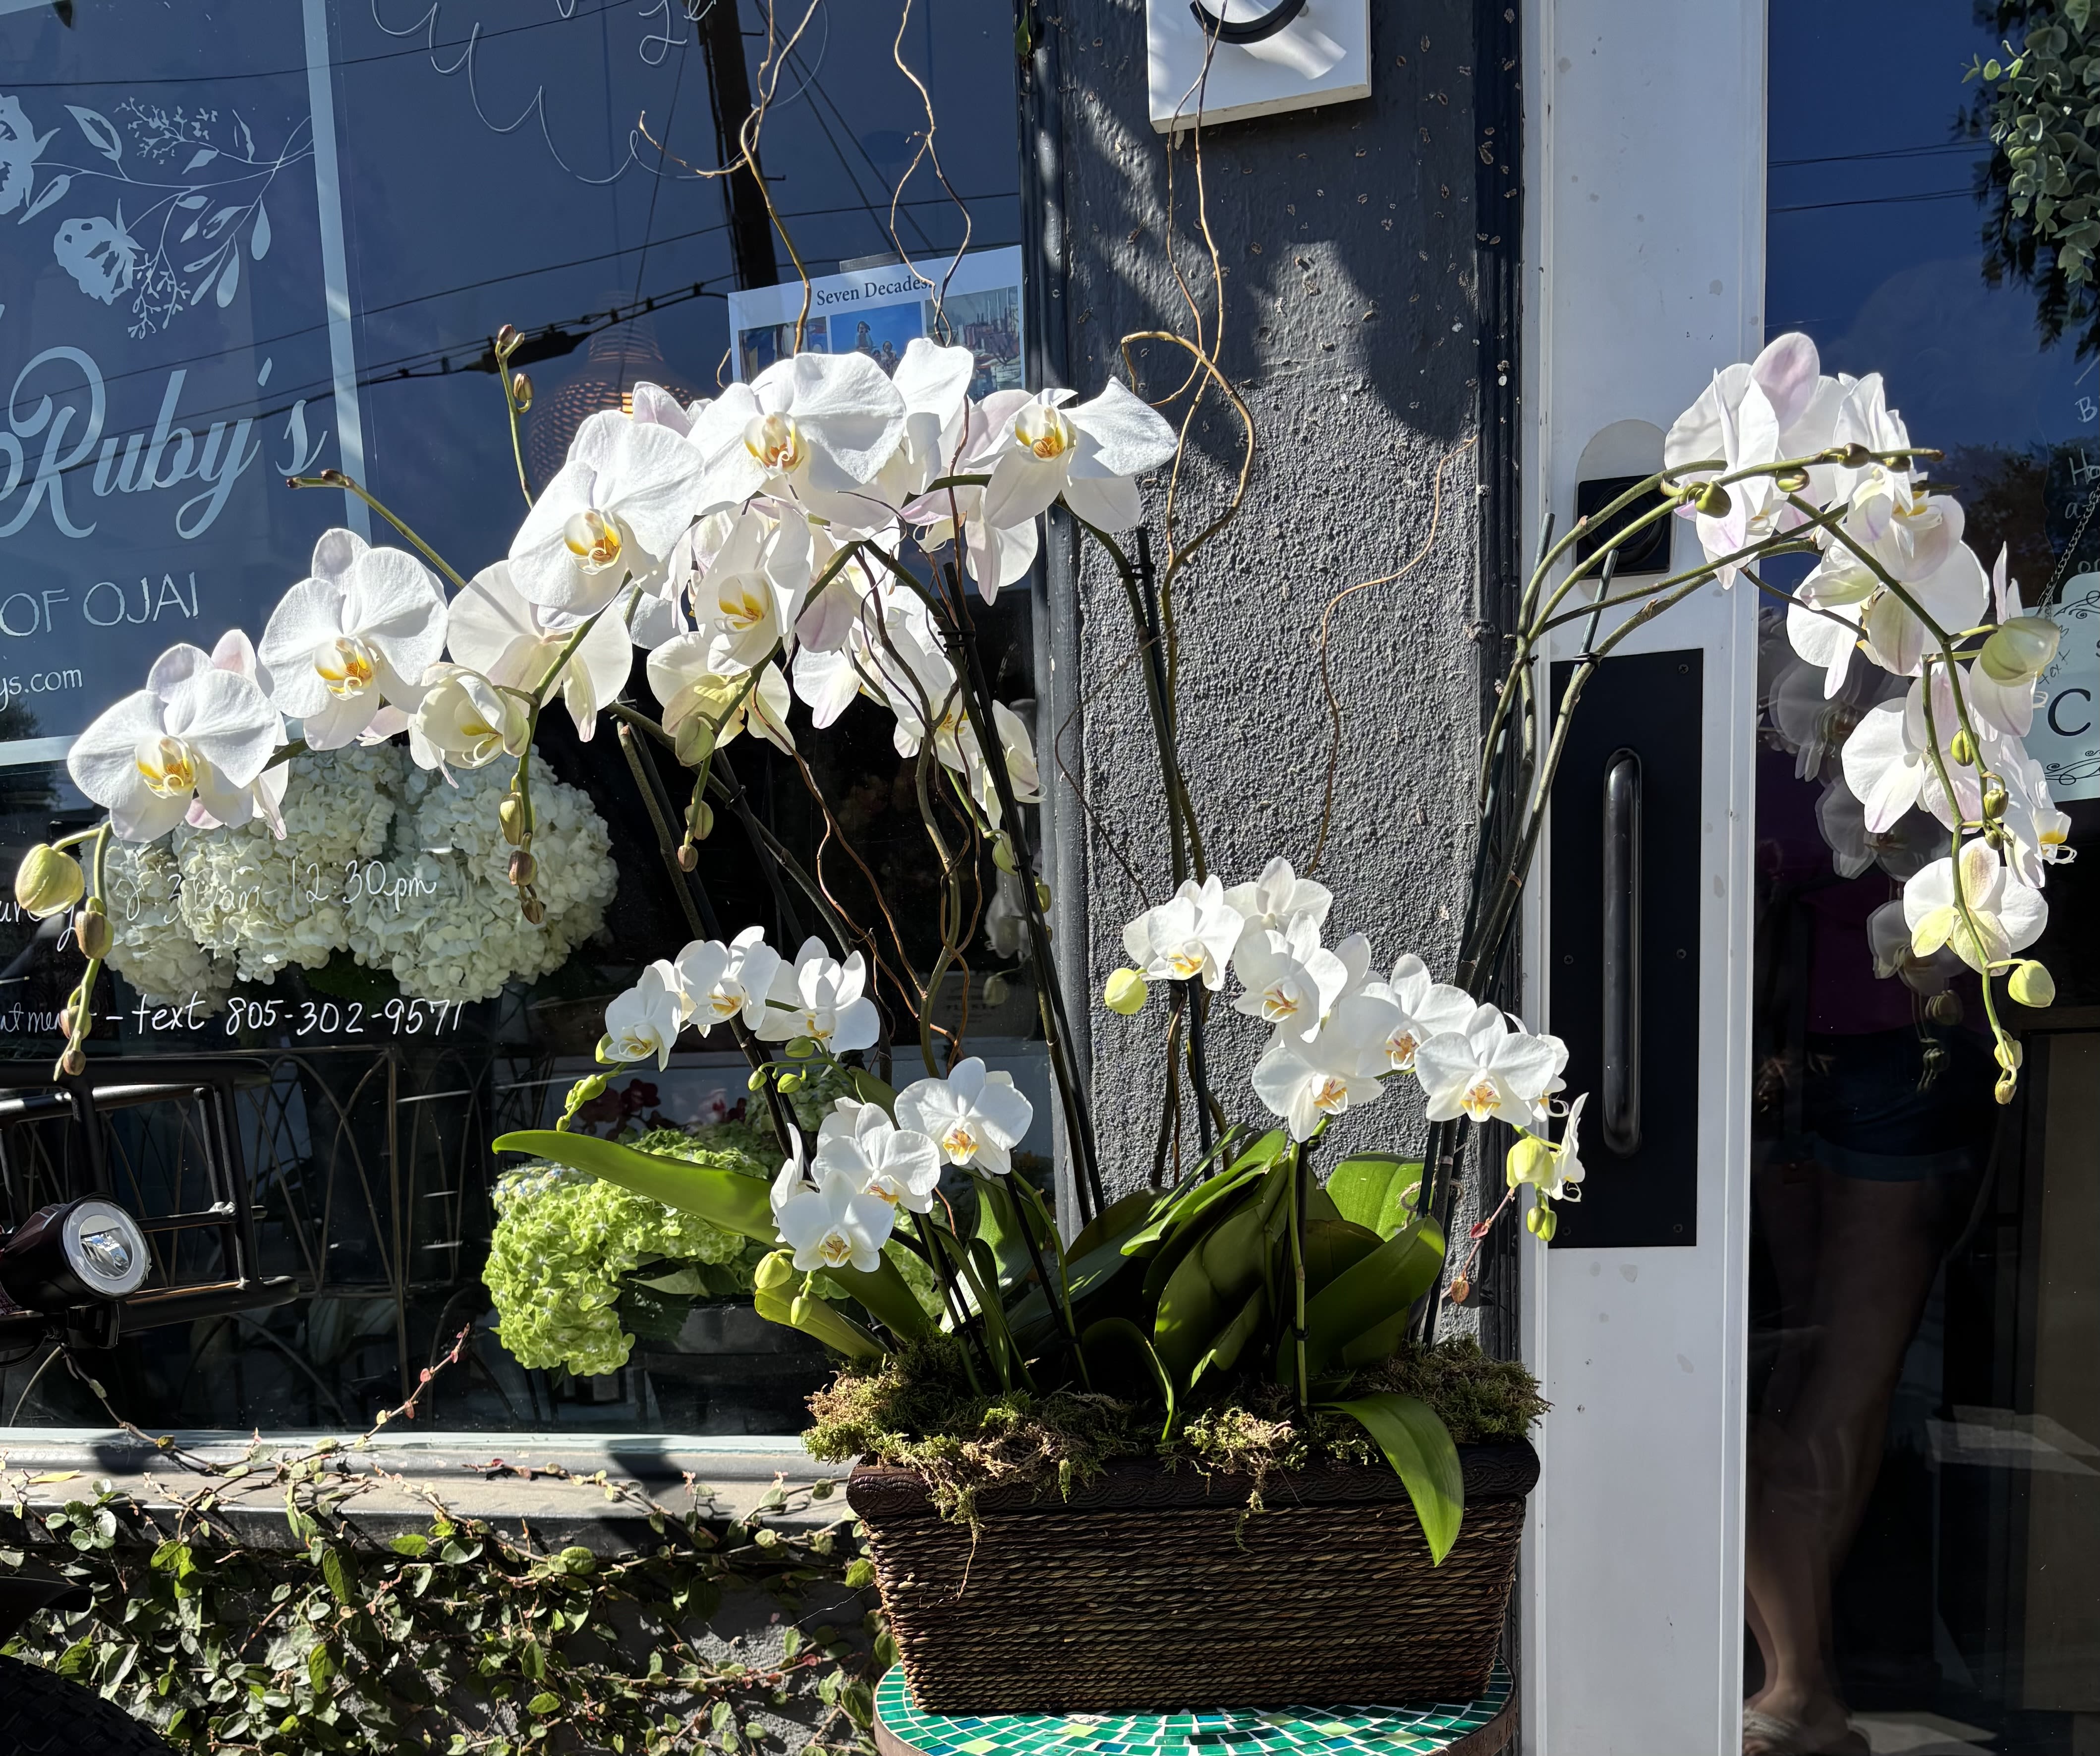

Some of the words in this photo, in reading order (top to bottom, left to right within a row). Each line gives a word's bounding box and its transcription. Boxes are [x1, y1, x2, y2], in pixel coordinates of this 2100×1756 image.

[816, 289, 860, 306] Seven
[0, 588, 70, 637] OF
[83, 571, 198, 626] OJAI
[131, 991, 206, 1035] text
[226, 997, 462, 1036] 805-302-9571
